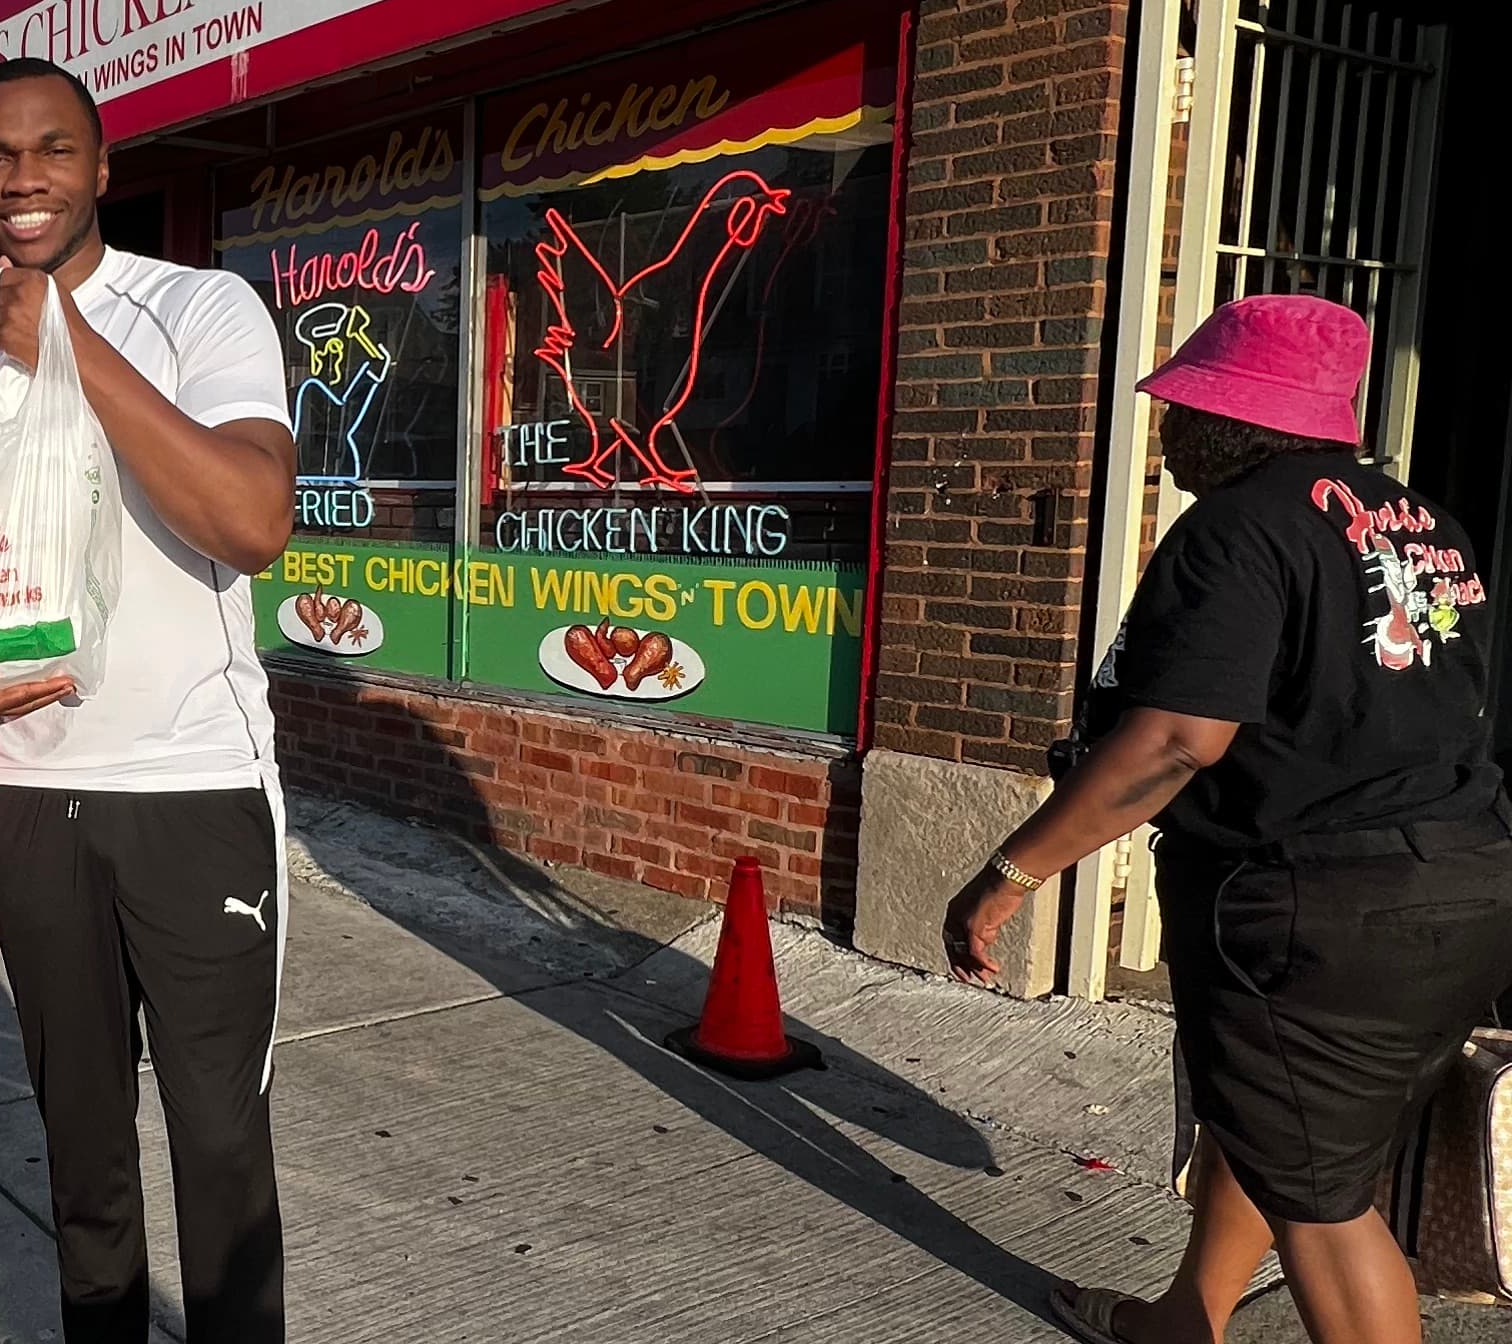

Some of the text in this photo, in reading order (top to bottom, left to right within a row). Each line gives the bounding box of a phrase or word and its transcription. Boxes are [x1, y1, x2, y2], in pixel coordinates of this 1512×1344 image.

[94, 2, 263, 93] WINGS IN TOWN
[499, 73, 731, 173] Chicken
[250, 124, 456, 232] Harold's
[270, 221, 435, 310] Harold's
[497, 420, 572, 467] THE
[496, 504, 792, 556] CHICKEN KING
[283, 550, 355, 588] BEST
[369, 556, 515, 609] CHICKEN
[531, 568, 678, 622] WINGS
[702, 578, 863, 638] TOWN
